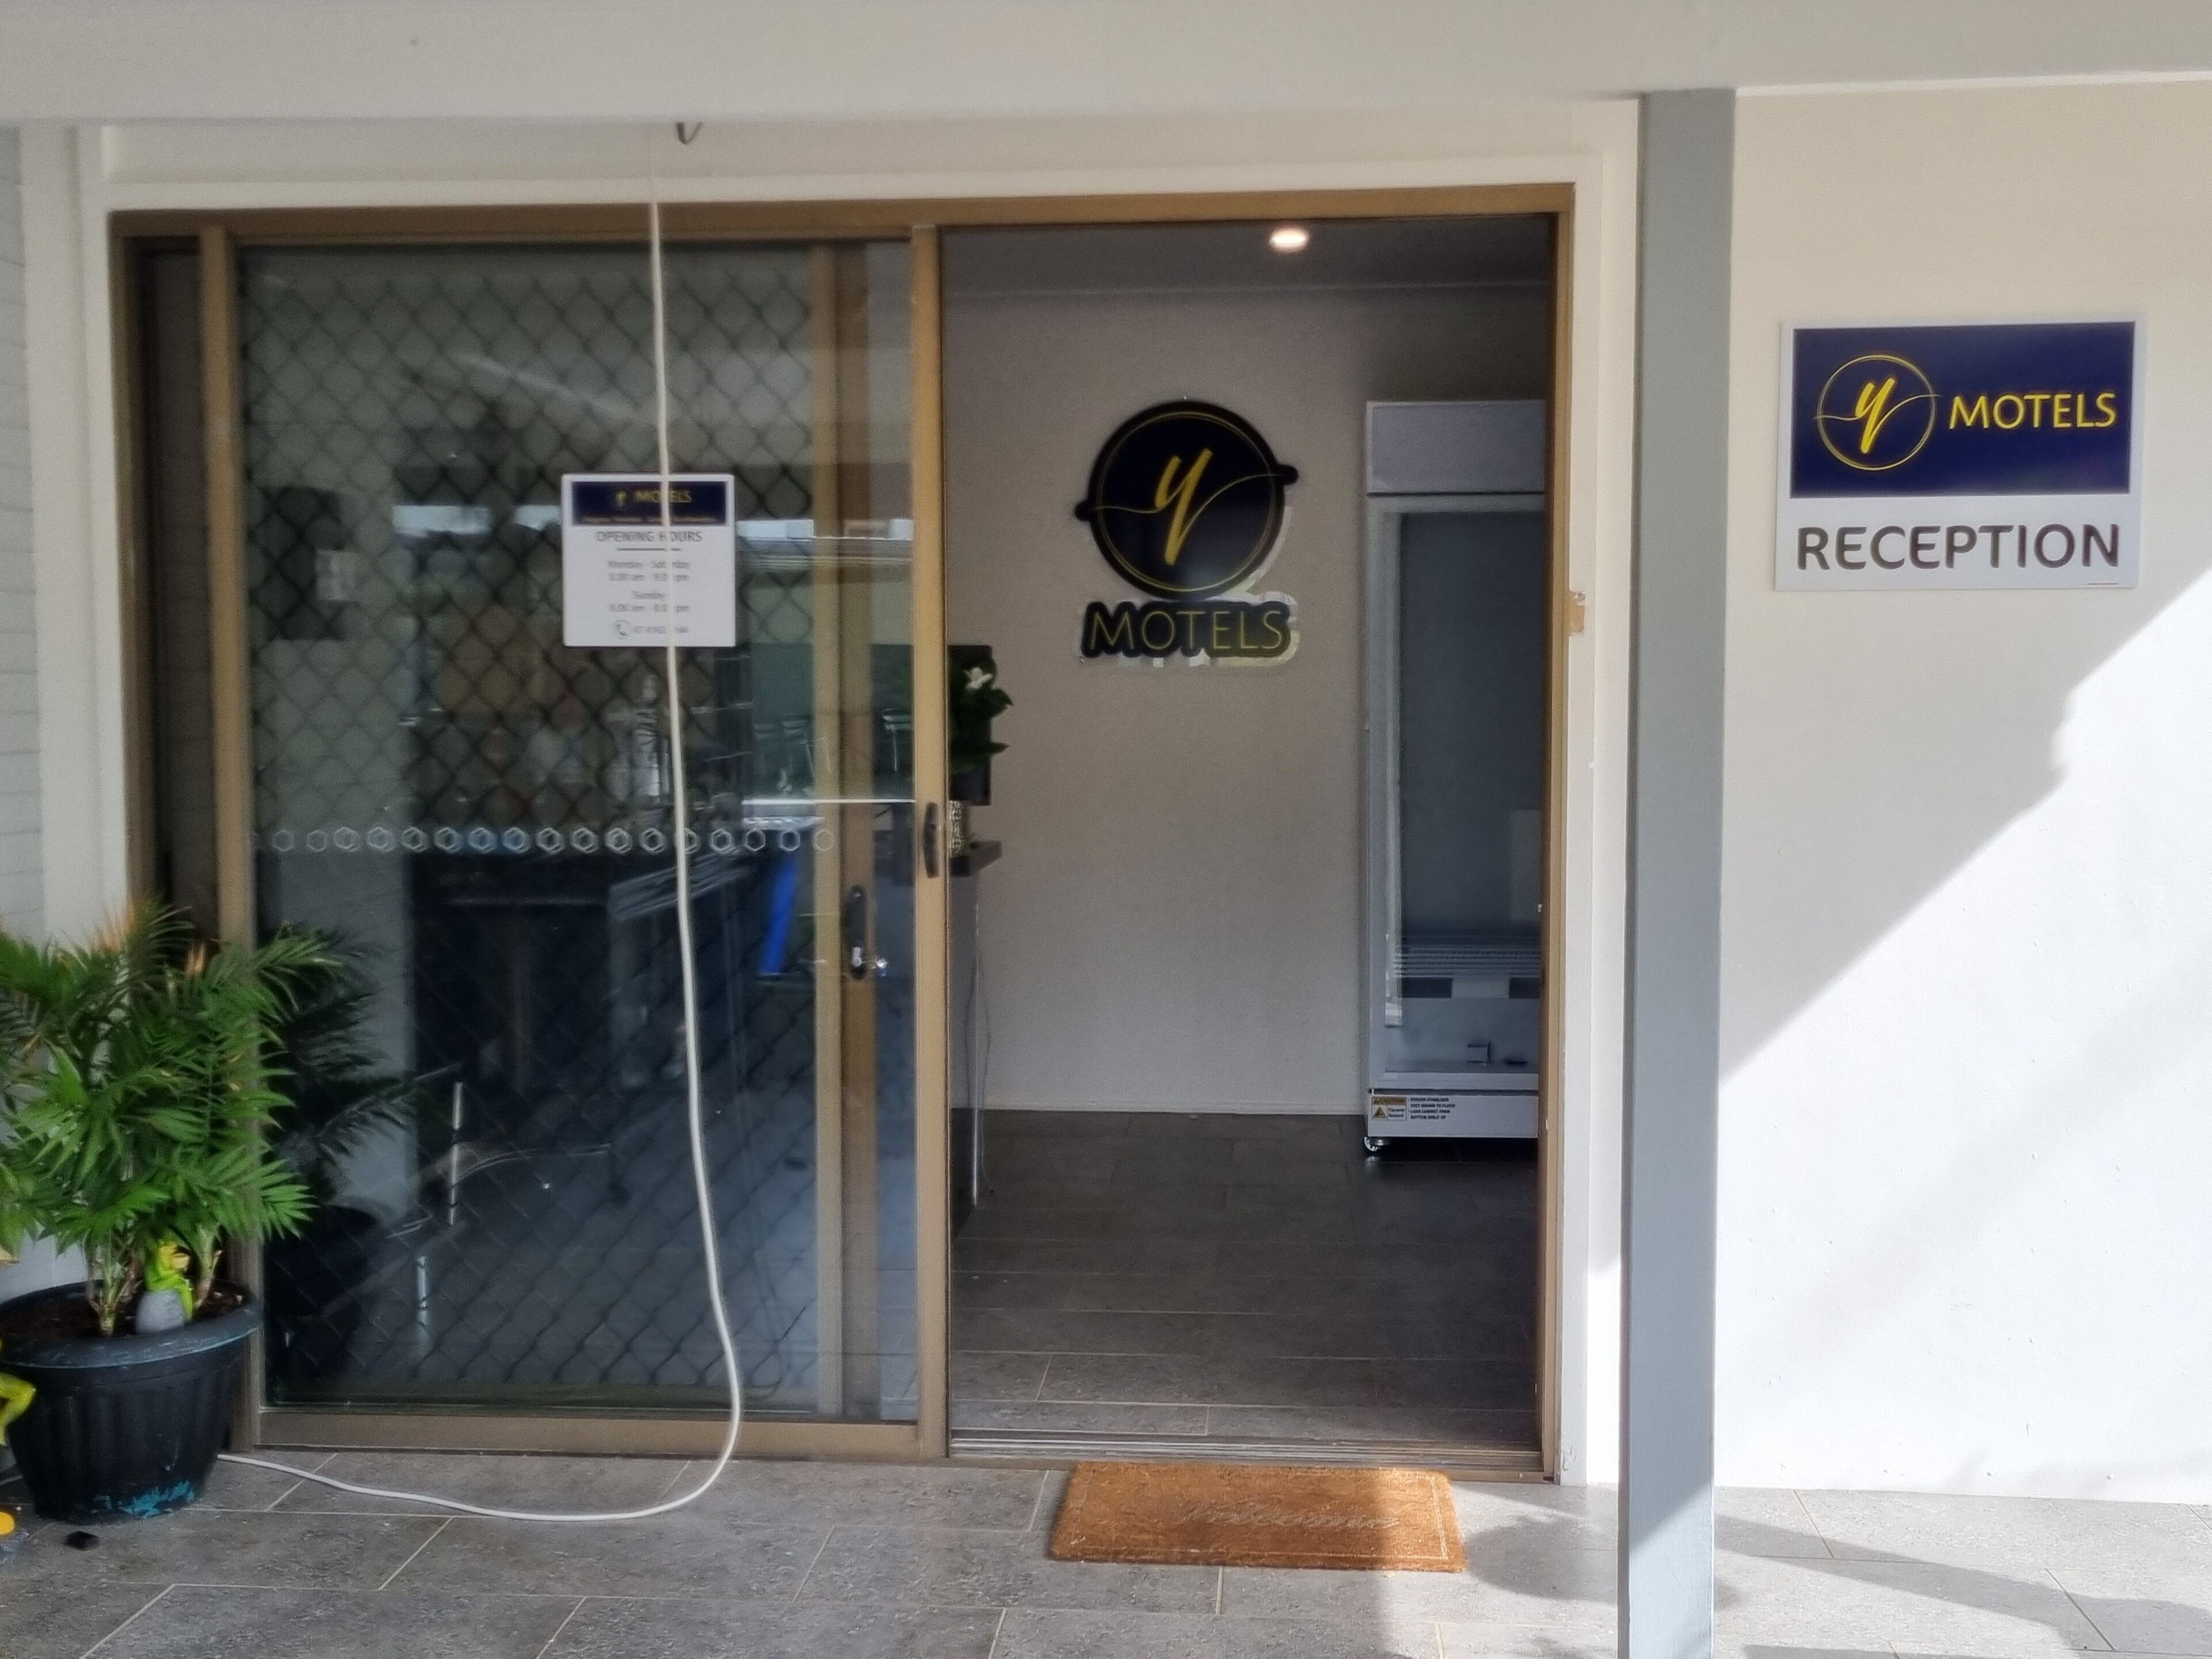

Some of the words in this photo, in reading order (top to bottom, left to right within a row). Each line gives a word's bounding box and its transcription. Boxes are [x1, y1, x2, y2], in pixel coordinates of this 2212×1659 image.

[1949, 392, 2117, 430] MOTELS
[635, 490, 692, 503] MOELS
[596, 531, 654, 542] OPENING
[1797, 523, 2120, 571] RECEPTION
[1090, 610, 1282, 650] MOTELS
